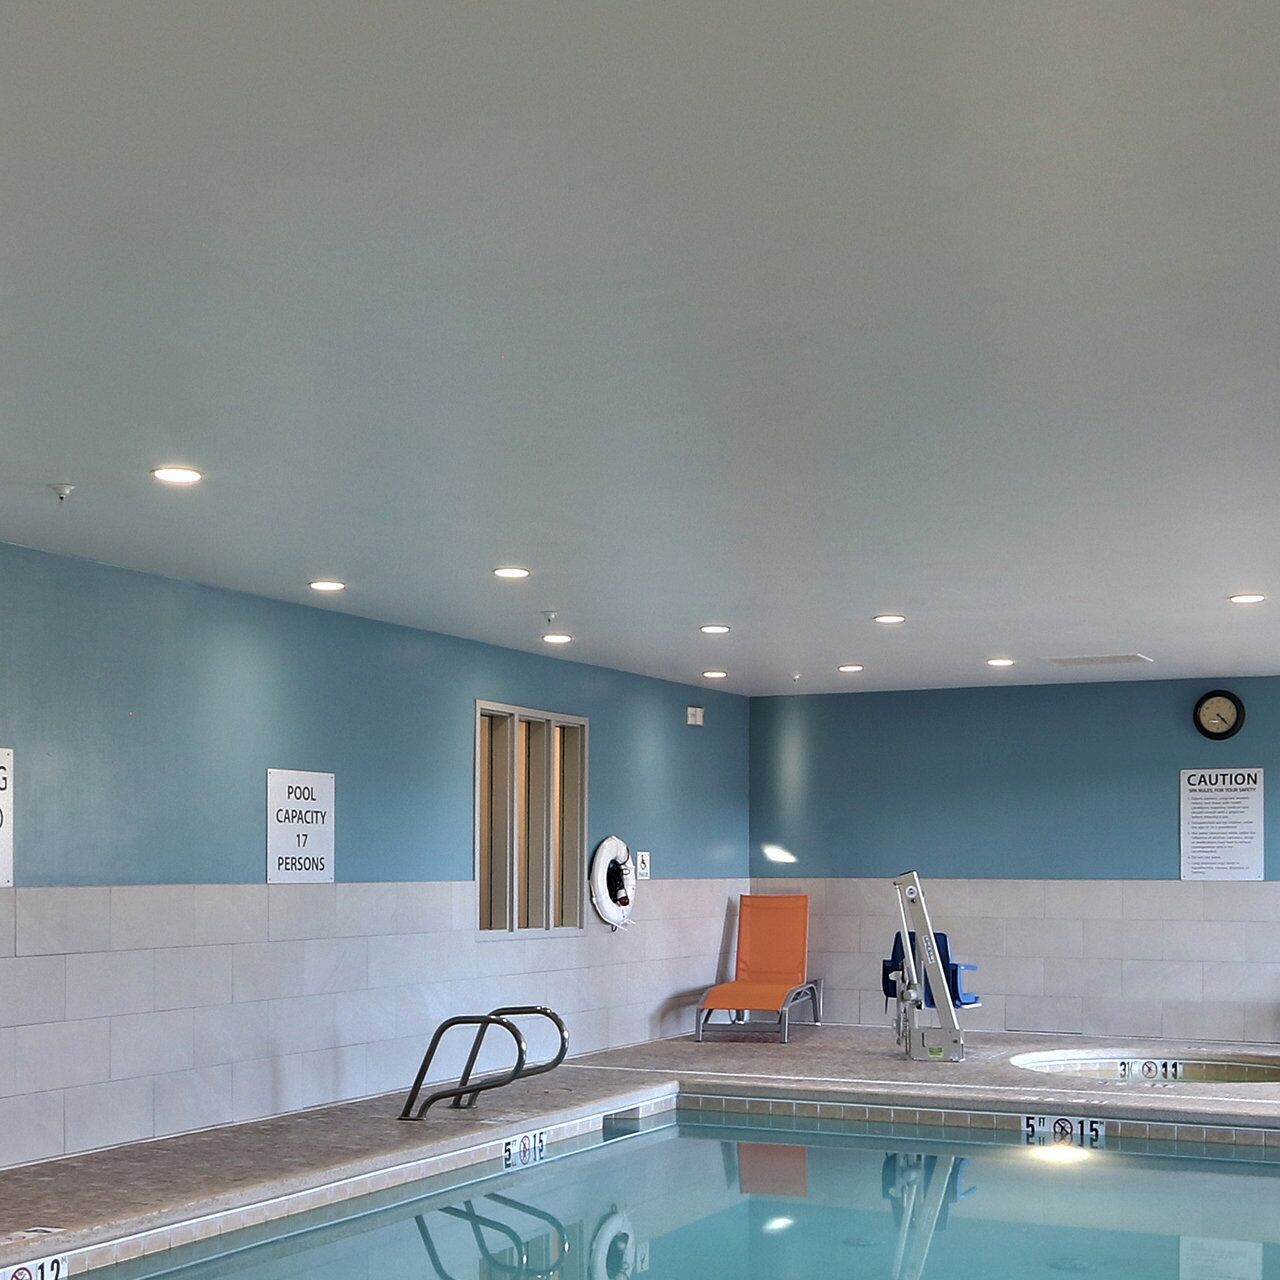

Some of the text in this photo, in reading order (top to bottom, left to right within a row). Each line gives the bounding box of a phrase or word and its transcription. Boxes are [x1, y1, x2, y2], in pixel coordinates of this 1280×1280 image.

[1187, 773, 1258, 786] CAUTION
[287, 785, 317, 801] POOL
[276, 808, 327, 825] CAPACITY
[296, 833, 308, 848] 17
[278, 856, 325, 871] PERSONS
[1026, 1116, 1035, 1134] 5
[1078, 1120, 1099, 1136] 15
[505, 1142, 511, 1159] 5
[533, 1132, 544, 1151] 15
